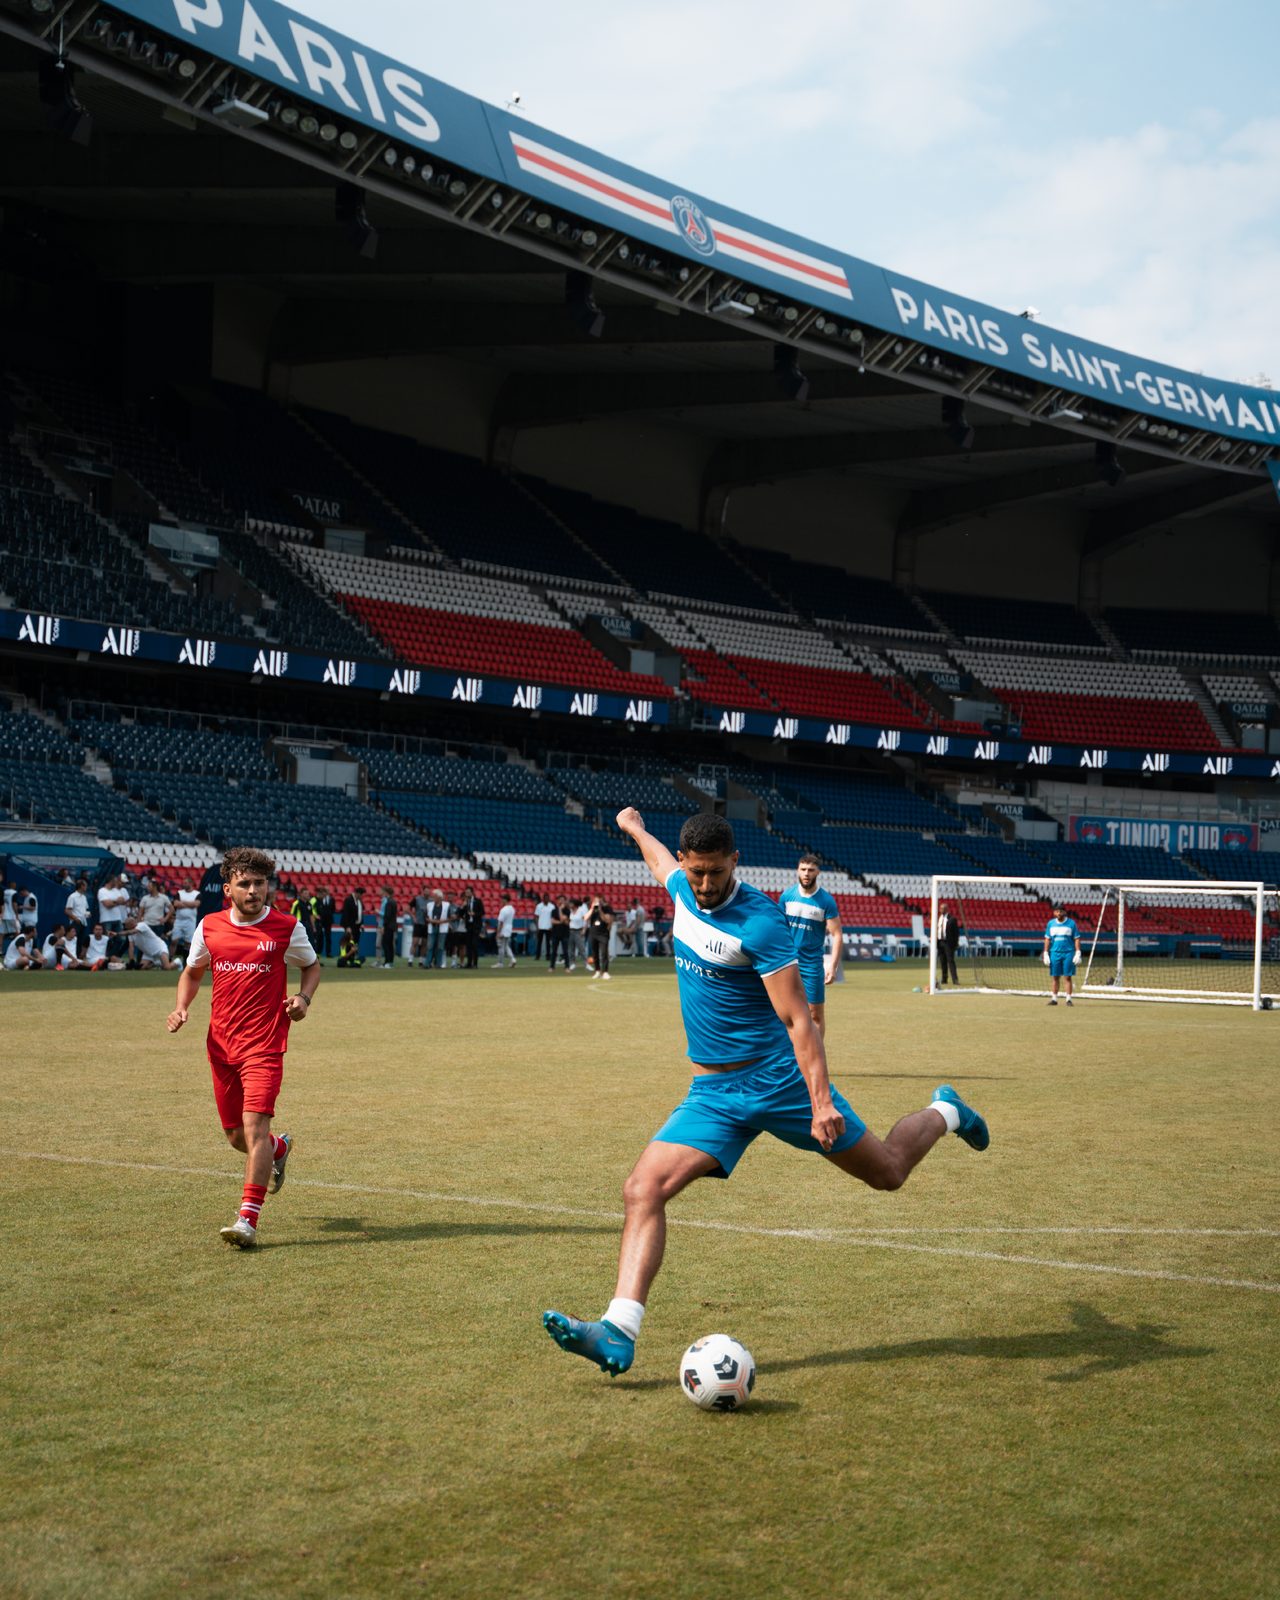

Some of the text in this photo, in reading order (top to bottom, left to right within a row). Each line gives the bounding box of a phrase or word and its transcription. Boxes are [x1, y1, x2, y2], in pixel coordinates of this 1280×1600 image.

[891, 287, 1009, 356] PARIS
[601, 616, 632, 630] QATAR
[932, 673, 960, 685] QATAR
[1232, 703, 1267, 714] QATAR
[1106, 821, 1220, 853] JUNIOR CLUB
[215, 960, 272, 973] MÖVENPICK
[674, 955, 725, 979] OVOTEL
